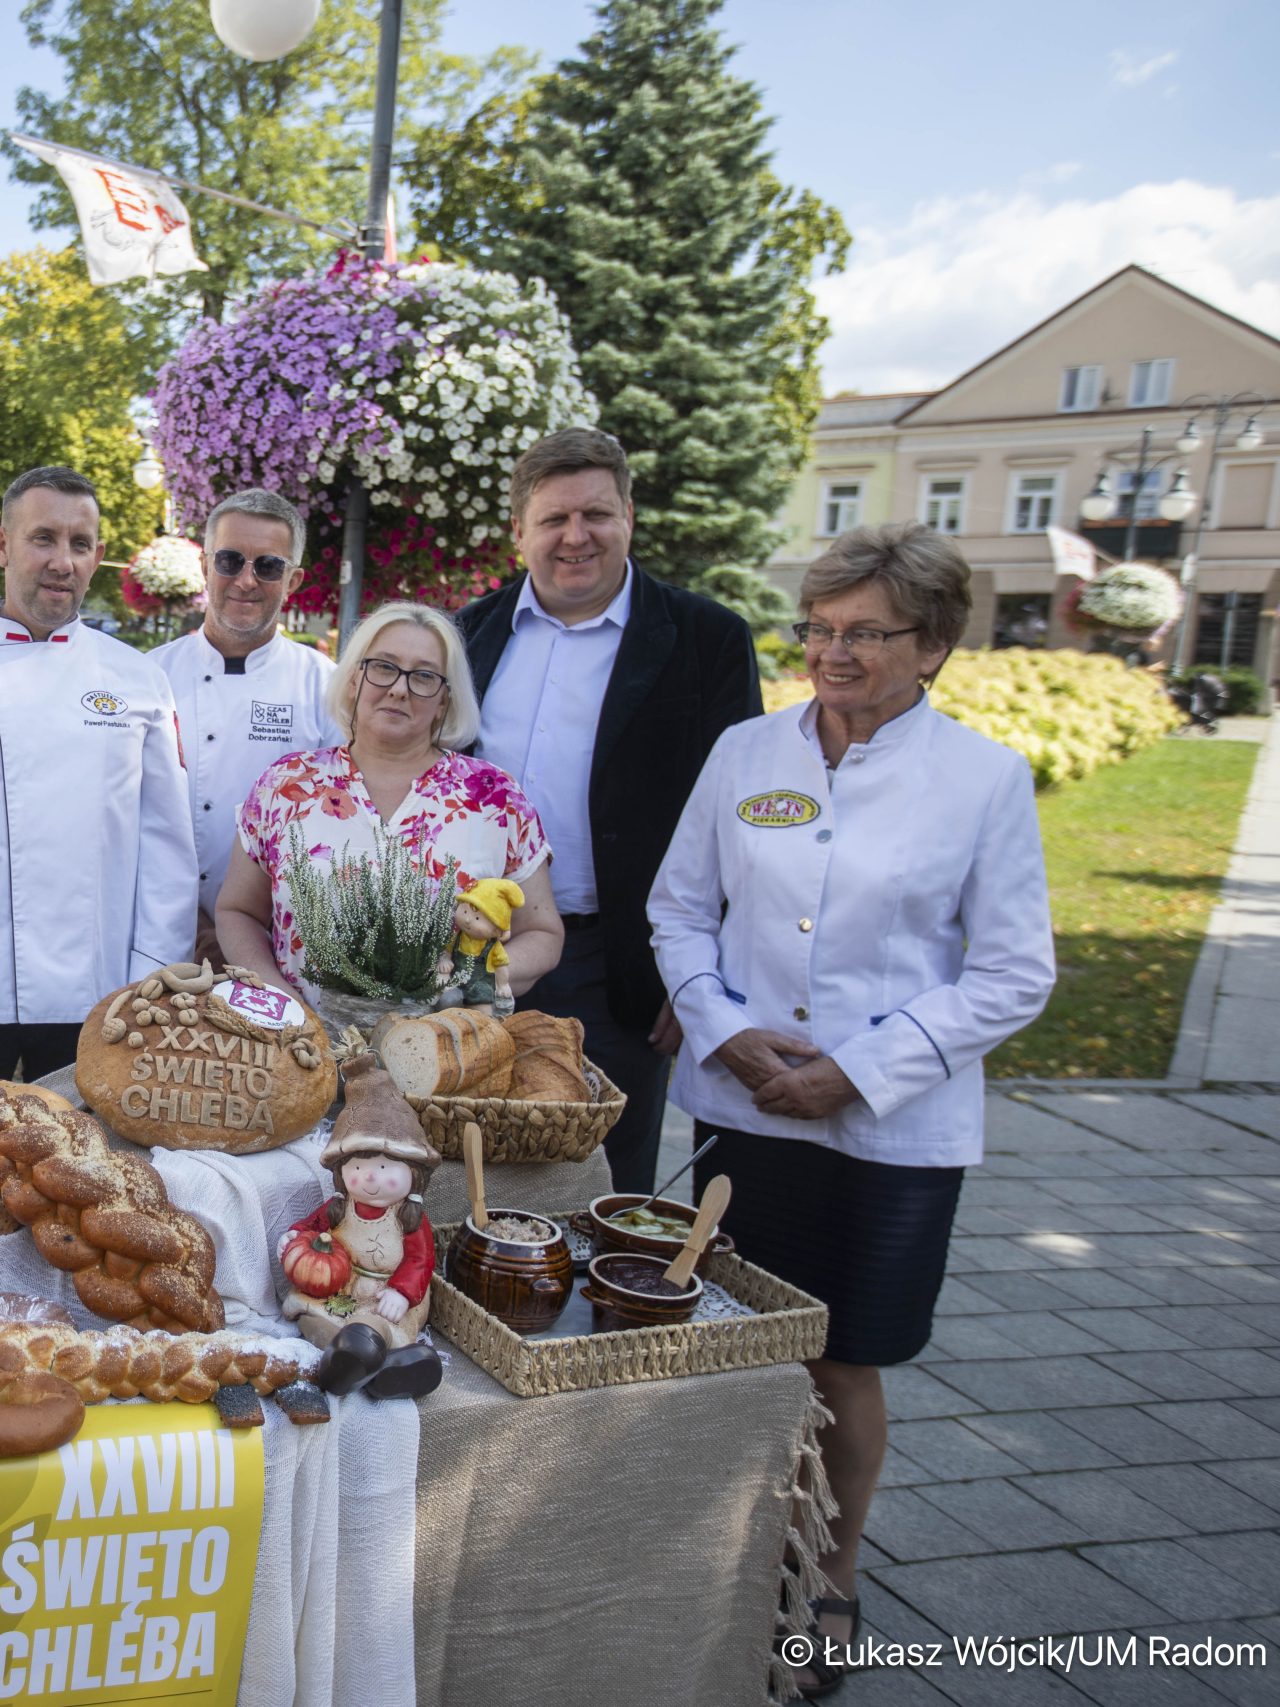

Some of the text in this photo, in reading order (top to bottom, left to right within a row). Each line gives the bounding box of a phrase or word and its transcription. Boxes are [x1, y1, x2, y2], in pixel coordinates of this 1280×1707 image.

[248, 733, 293, 743] Dobrzański
[252, 725, 291, 735] Sebastian
[156, 1026, 273, 1070] XXVIII
[120, 1085, 275, 1134] CHLEBA
[56, 1429, 235, 1522] XXVIII
[0, 1521, 231, 1626] ŚWIĘTO
